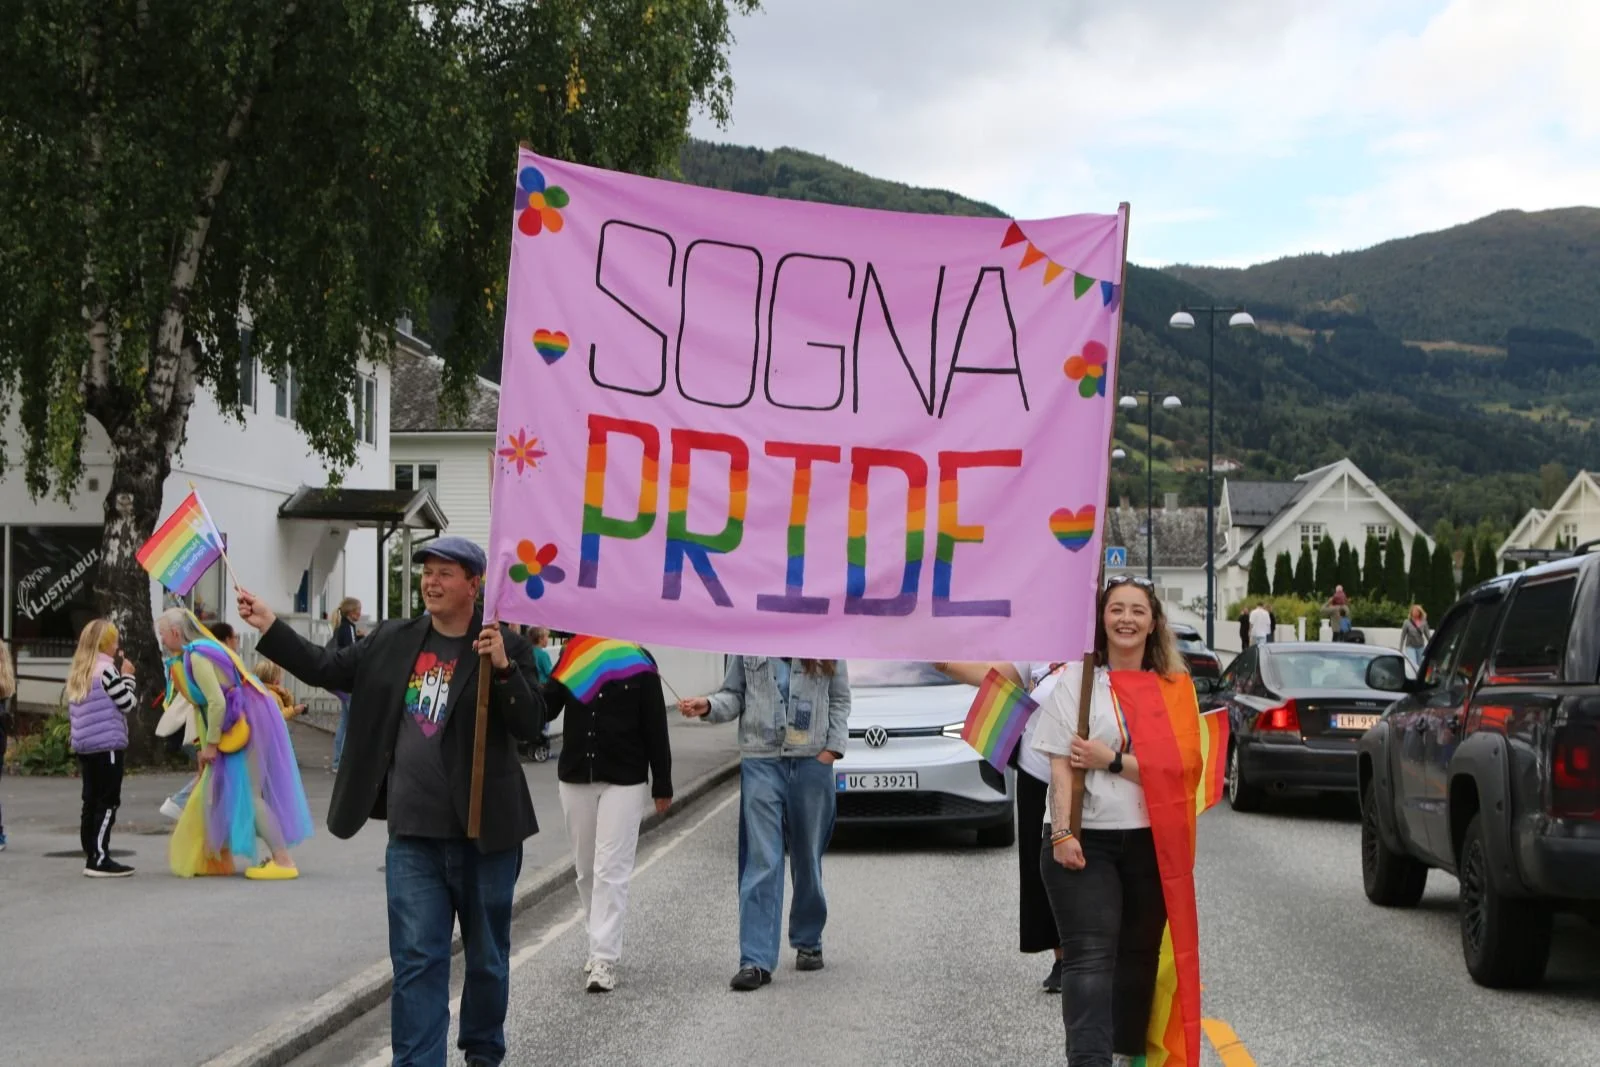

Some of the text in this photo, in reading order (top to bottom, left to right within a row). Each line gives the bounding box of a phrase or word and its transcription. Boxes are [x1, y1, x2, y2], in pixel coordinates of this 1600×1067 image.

[589, 219, 1030, 419] SOGNA
[578, 413, 1022, 618] PRIDE
[30, 548, 104, 615] LUSTRABUI
[1341, 715, 1355, 727] LH
[849, 775, 913, 789] UC 33921
